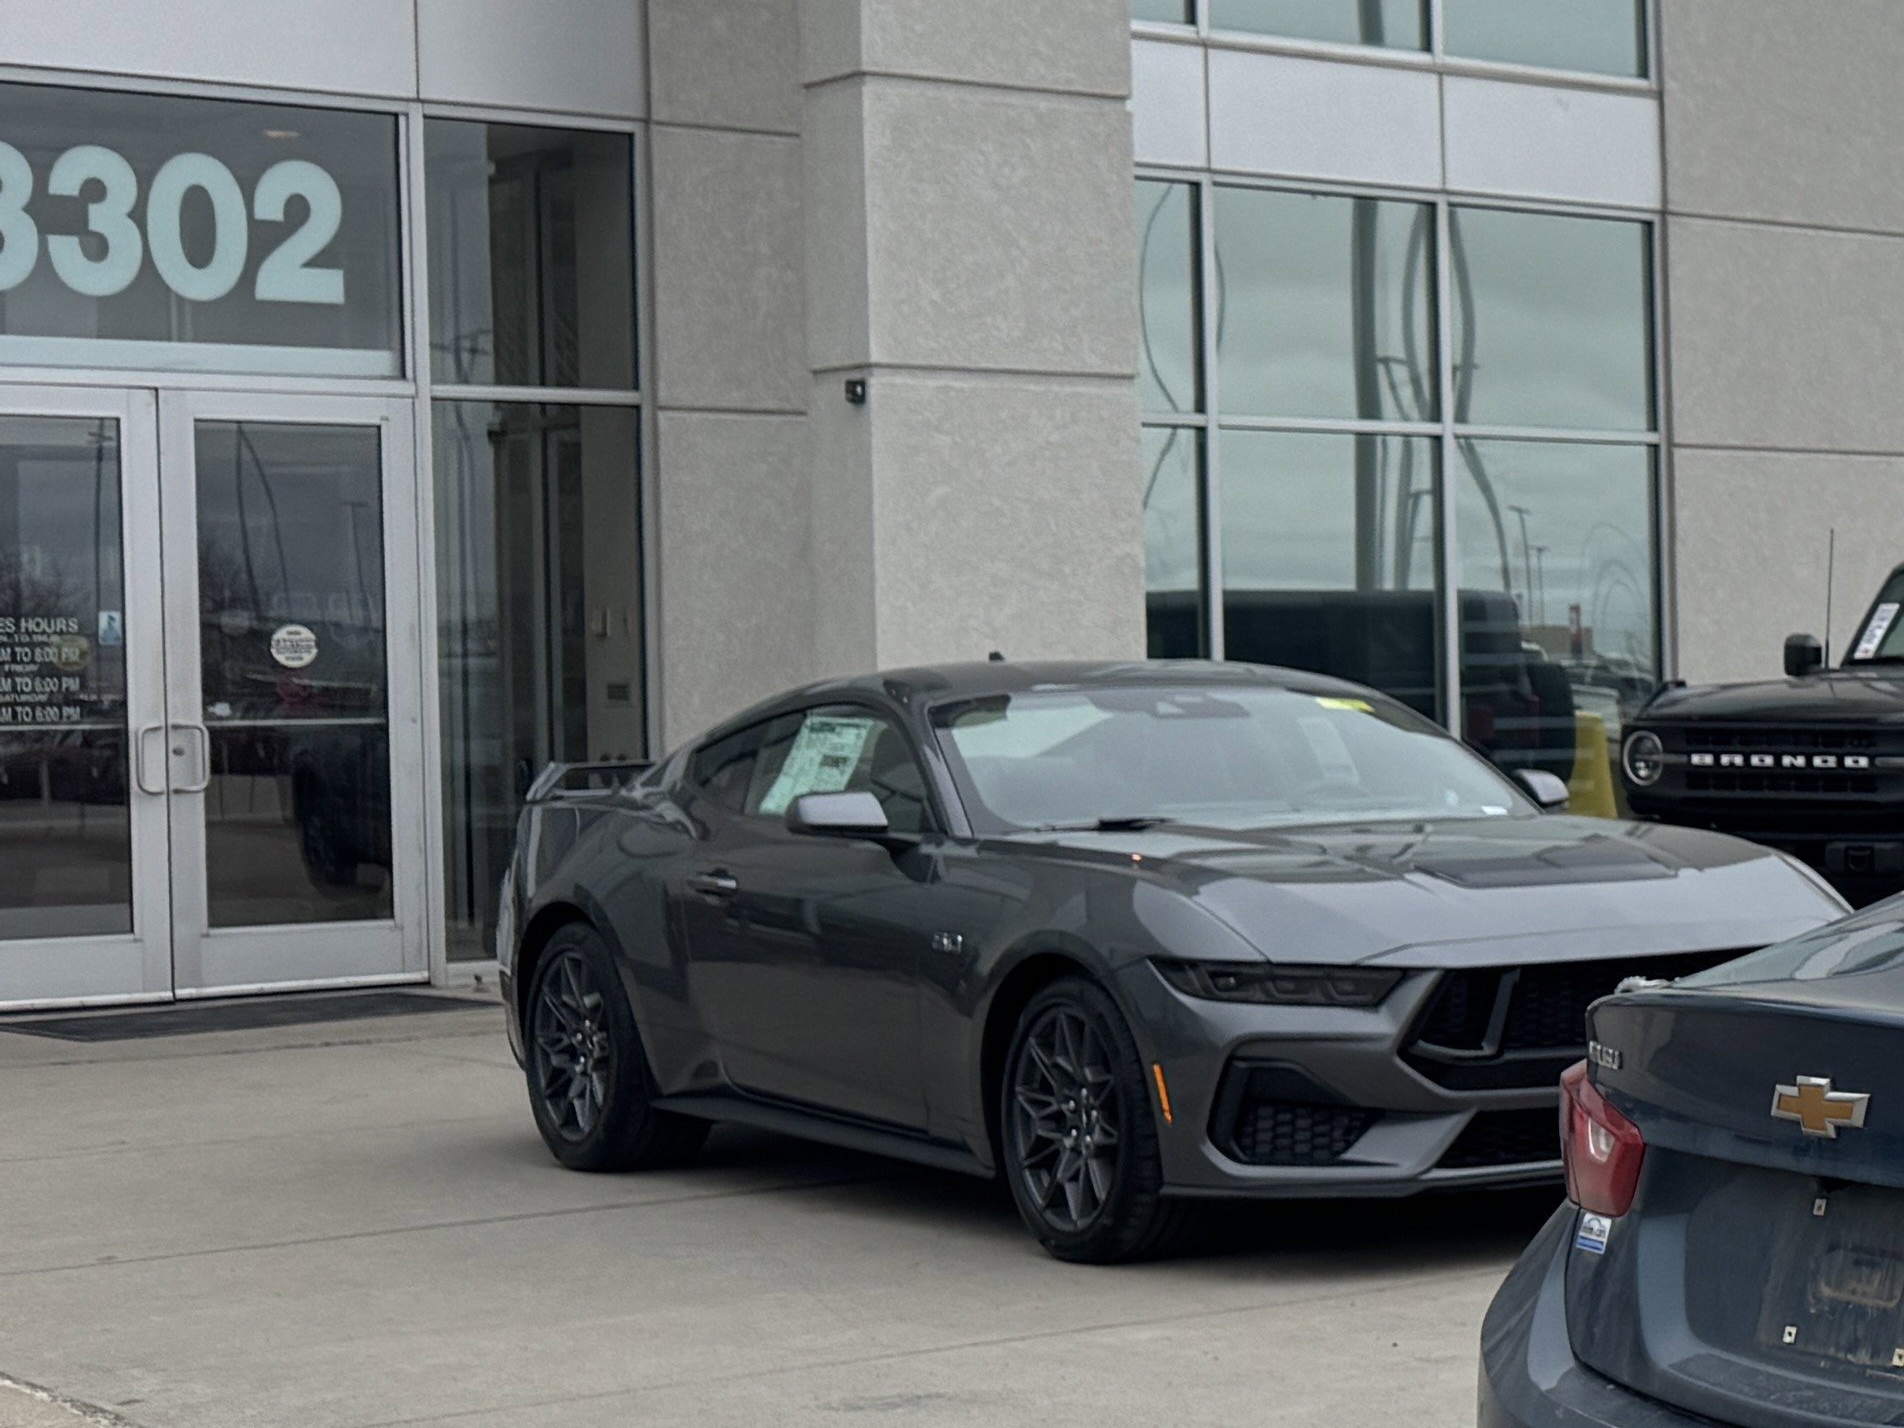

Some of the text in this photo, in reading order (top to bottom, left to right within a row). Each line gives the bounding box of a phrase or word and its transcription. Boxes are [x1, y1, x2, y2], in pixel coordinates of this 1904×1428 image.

[20, 617, 79, 633] HOURS
[14, 646, 32, 662] TO
[14, 676, 32, 692] TO
[61, 676, 80, 692] PM
[15, 705, 33, 722] TO
[62, 706, 81, 722] PM
[1690, 753, 1869, 768] BRONCO
